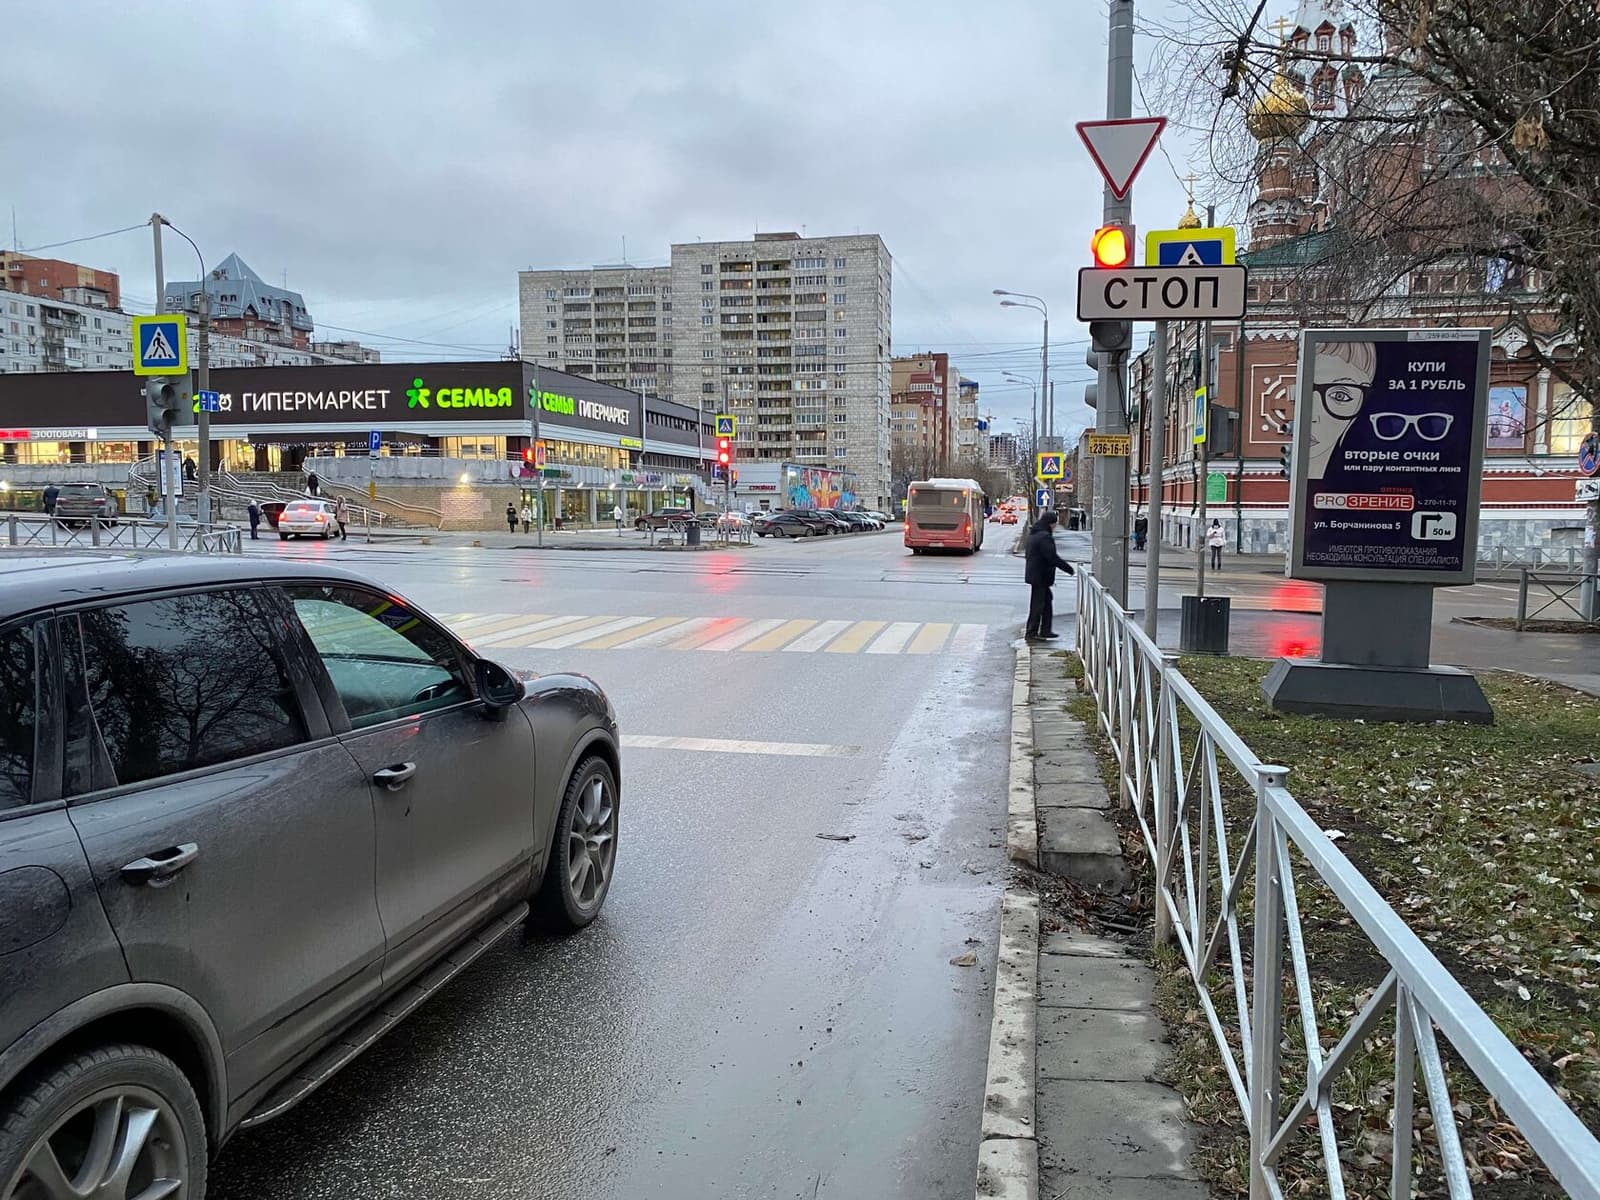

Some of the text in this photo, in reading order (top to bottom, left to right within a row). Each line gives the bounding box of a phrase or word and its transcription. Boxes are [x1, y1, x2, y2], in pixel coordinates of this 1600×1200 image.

[1104, 276, 1219, 309] СТОП
[1408, 361, 1446, 372] КУПИ
[1388, 379, 1466, 390] ЗА 1 РУБЛЬ
[241, 387, 512, 412] ГИПЕРМАРКЕТ СЕМЬЯ
[542, 391, 630, 426] СЕМЬЯ ГИПЕРМАРКЕТ
[34, 430, 87, 439] ЗООТОВАРЫ
[1344, 450, 1440, 462] вторые очки
[1362, 464, 1384, 473] пару
[1423, 499, 1457, 507] 270-11-70
[1314, 520, 1401, 530] ул. Борчанинова 5
[1432, 528, 1443, 536] 50
[1328, 544, 1438, 555] ИМЕЮТСЯ ПРОТИВОПОКАЗАНИЯ
[1306, 552, 1353, 561] НЕОБХОДИМА
[1353, 553, 1408, 563] КОНСУЛЬТАЦИЯ
[1407, 555, 1460, 565] СПЕЦИАЛИСТА
